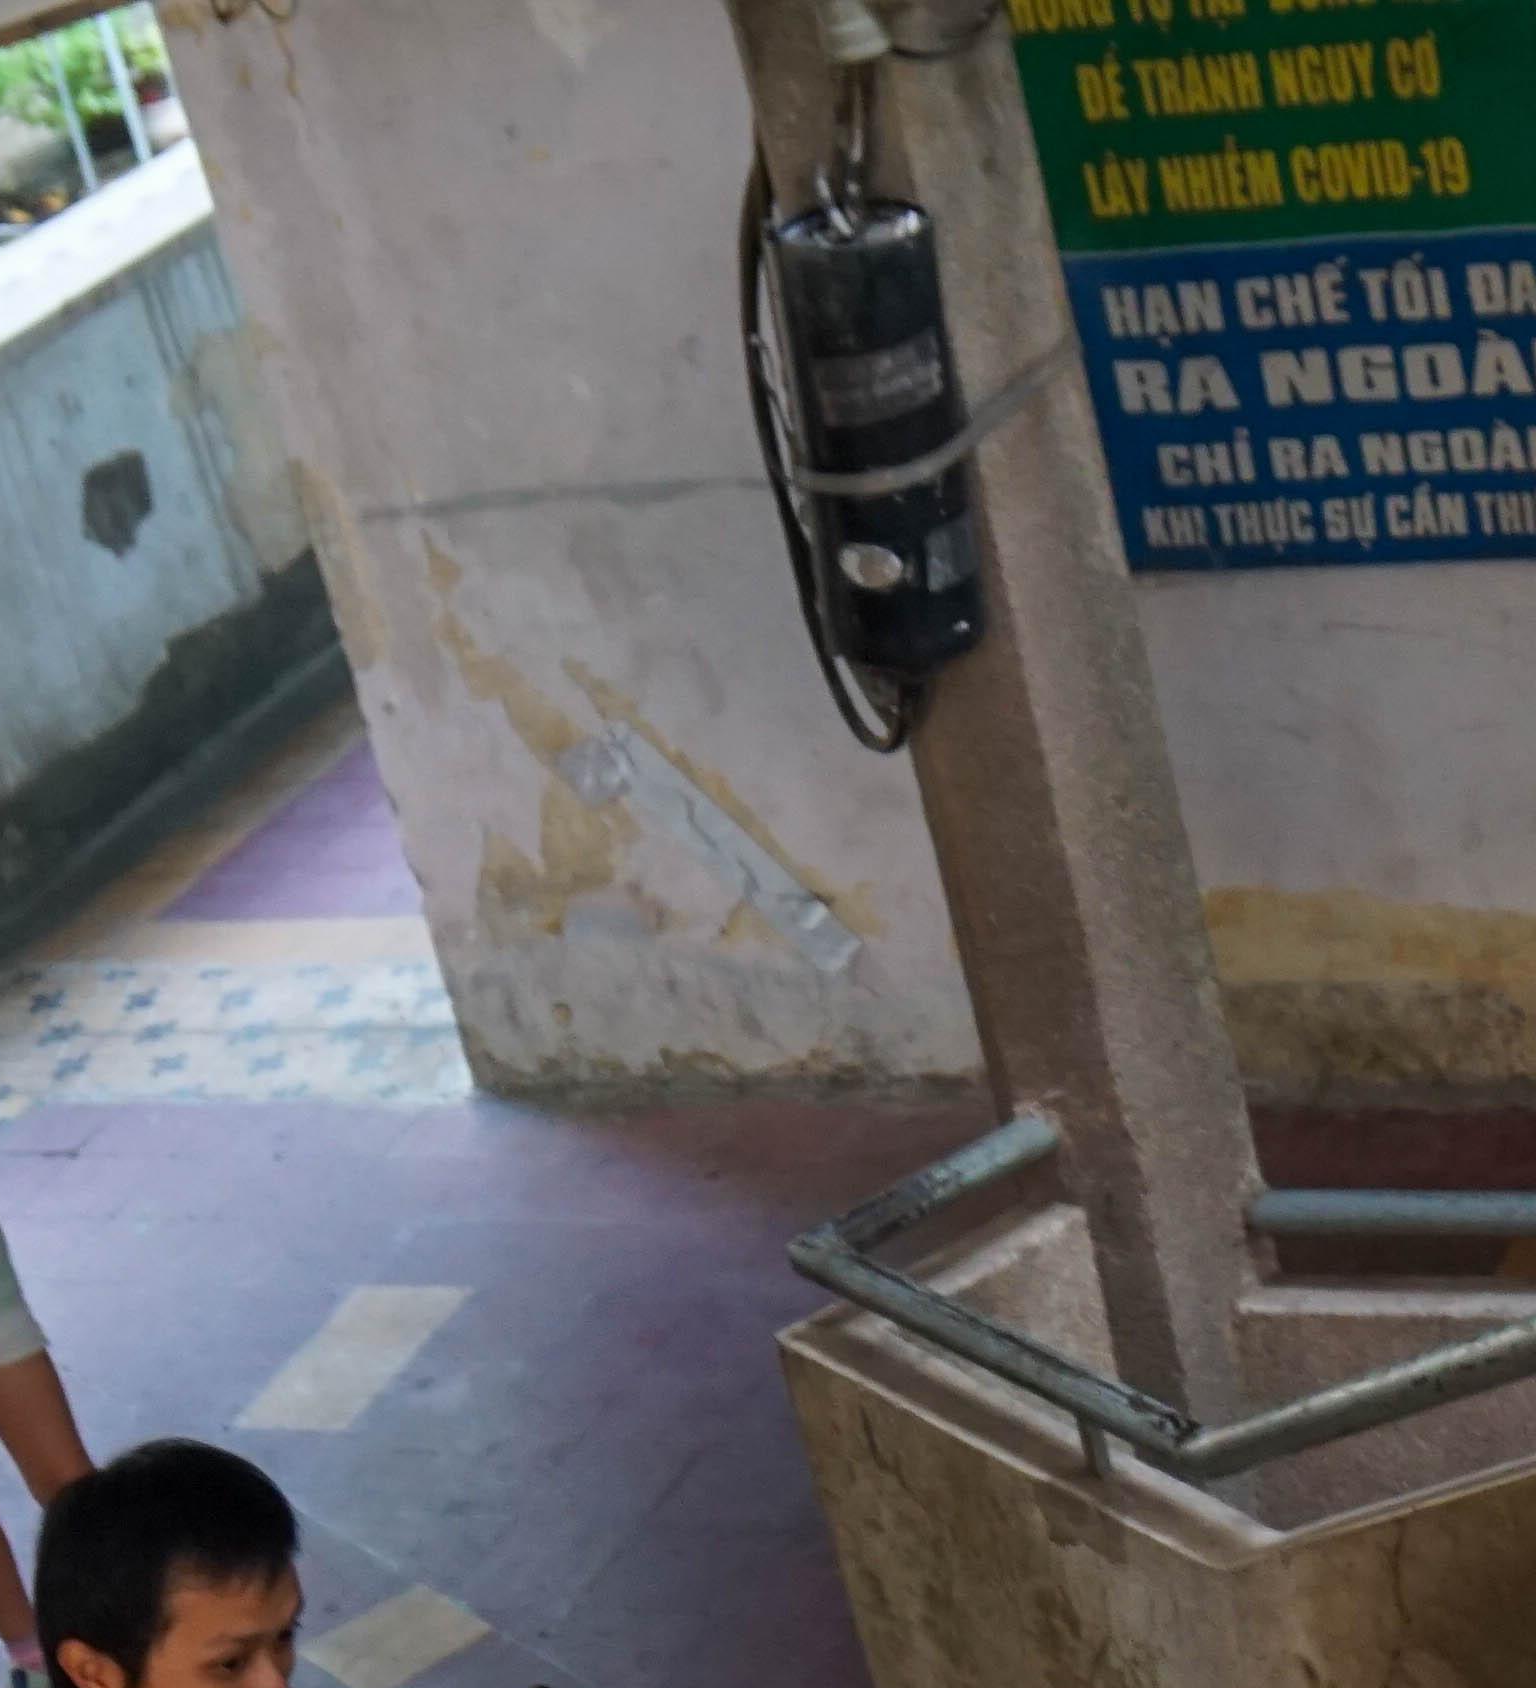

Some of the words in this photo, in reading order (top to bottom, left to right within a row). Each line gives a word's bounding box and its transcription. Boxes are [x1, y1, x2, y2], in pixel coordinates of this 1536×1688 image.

[1268, 42, 1374, 106] NGUY
[1386, 31, 1442, 99] CƠ
[1290, 137, 1471, 203] COVID-19
[1102, 280, 1224, 348] HẠN
[1235, 254, 1351, 329] CHẾ
[1359, 251, 1453, 321] TỐI
[1113, 356, 1240, 414] RA
[1158, 427, 1256, 486] CHỈ
[1268, 435, 1350, 480] RA
[1143, 506, 1207, 547] KHI
[1214, 496, 1315, 555] THỰC
[1324, 493, 1378, 550] SỰ
